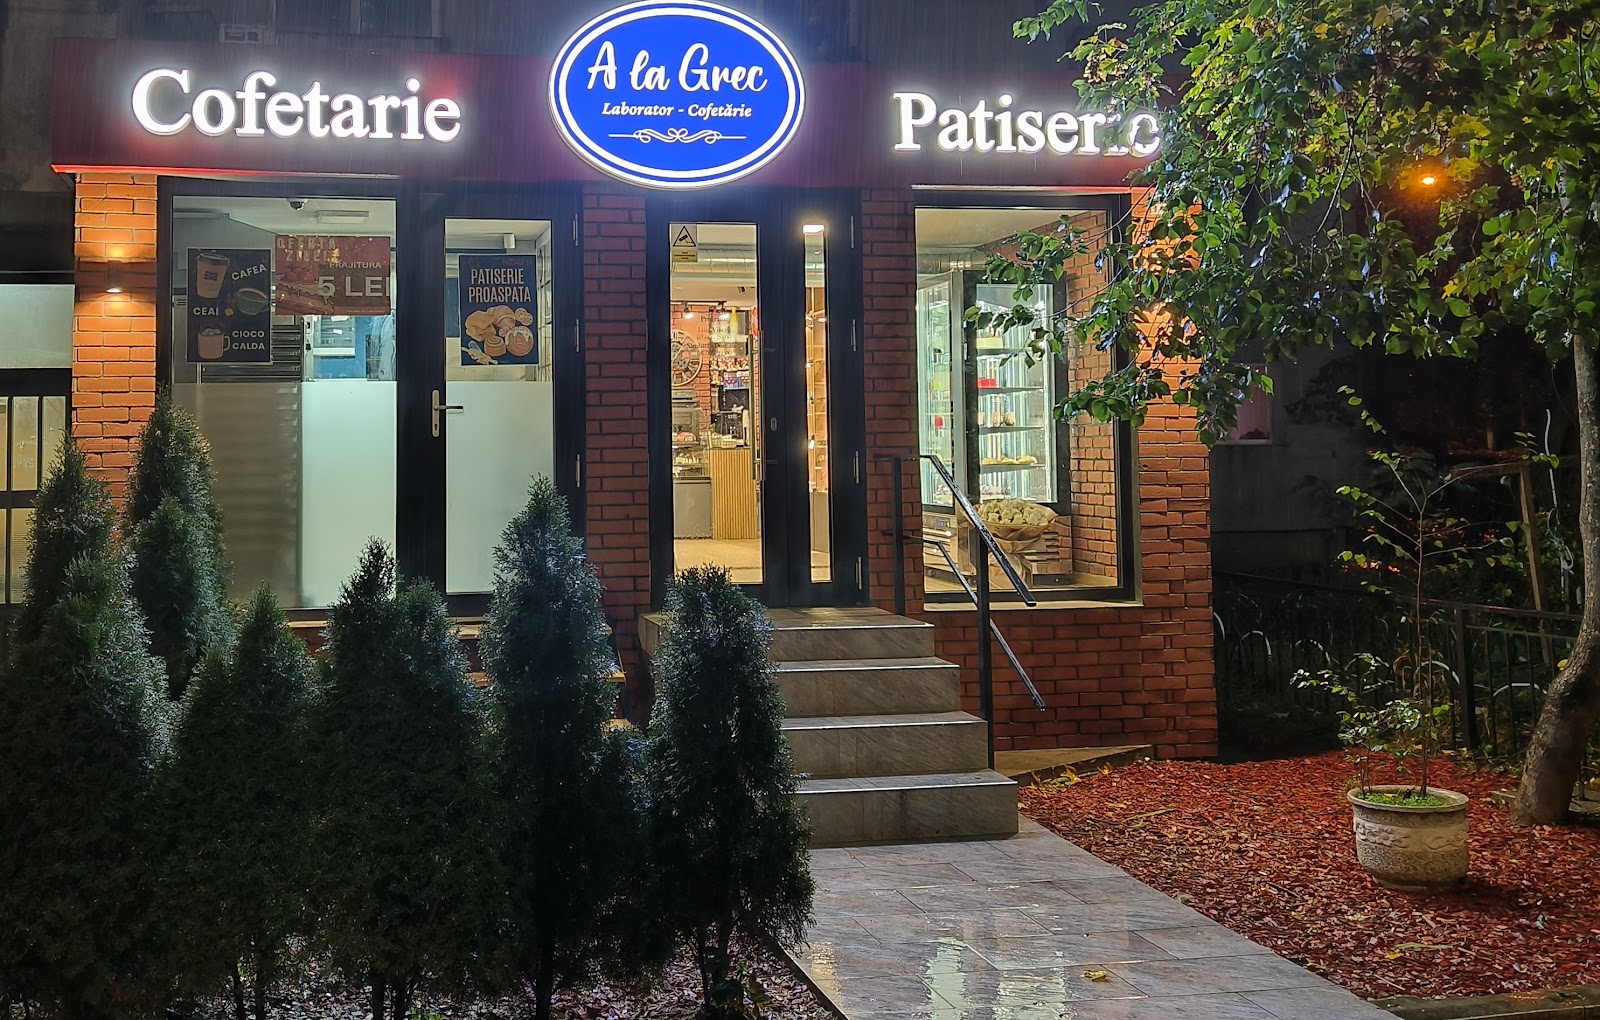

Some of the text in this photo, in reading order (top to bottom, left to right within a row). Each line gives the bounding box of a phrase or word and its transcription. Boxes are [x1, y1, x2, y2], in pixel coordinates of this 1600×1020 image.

[587, 40, 768, 92] A la Grec
[131, 68, 461, 142] Cofetarie
[602, 101, 675, 116] Laborator
[687, 103, 752, 120] Cofetărie
[893, 92, 1161, 157] Patisere
[277, 237, 336, 249] OFERTA
[231, 263, 267, 281] CAFEA
[329, 261, 382, 269] PRAJITURA
[470, 268, 525, 285] PATISERIE
[318, 275, 390, 297] 5 LEI
[468, 286, 532, 303] PROASPATA
[193, 307, 219, 316] CEAI
[232, 330, 265, 338] CIOCO
[232, 342, 265, 350] CALDA
